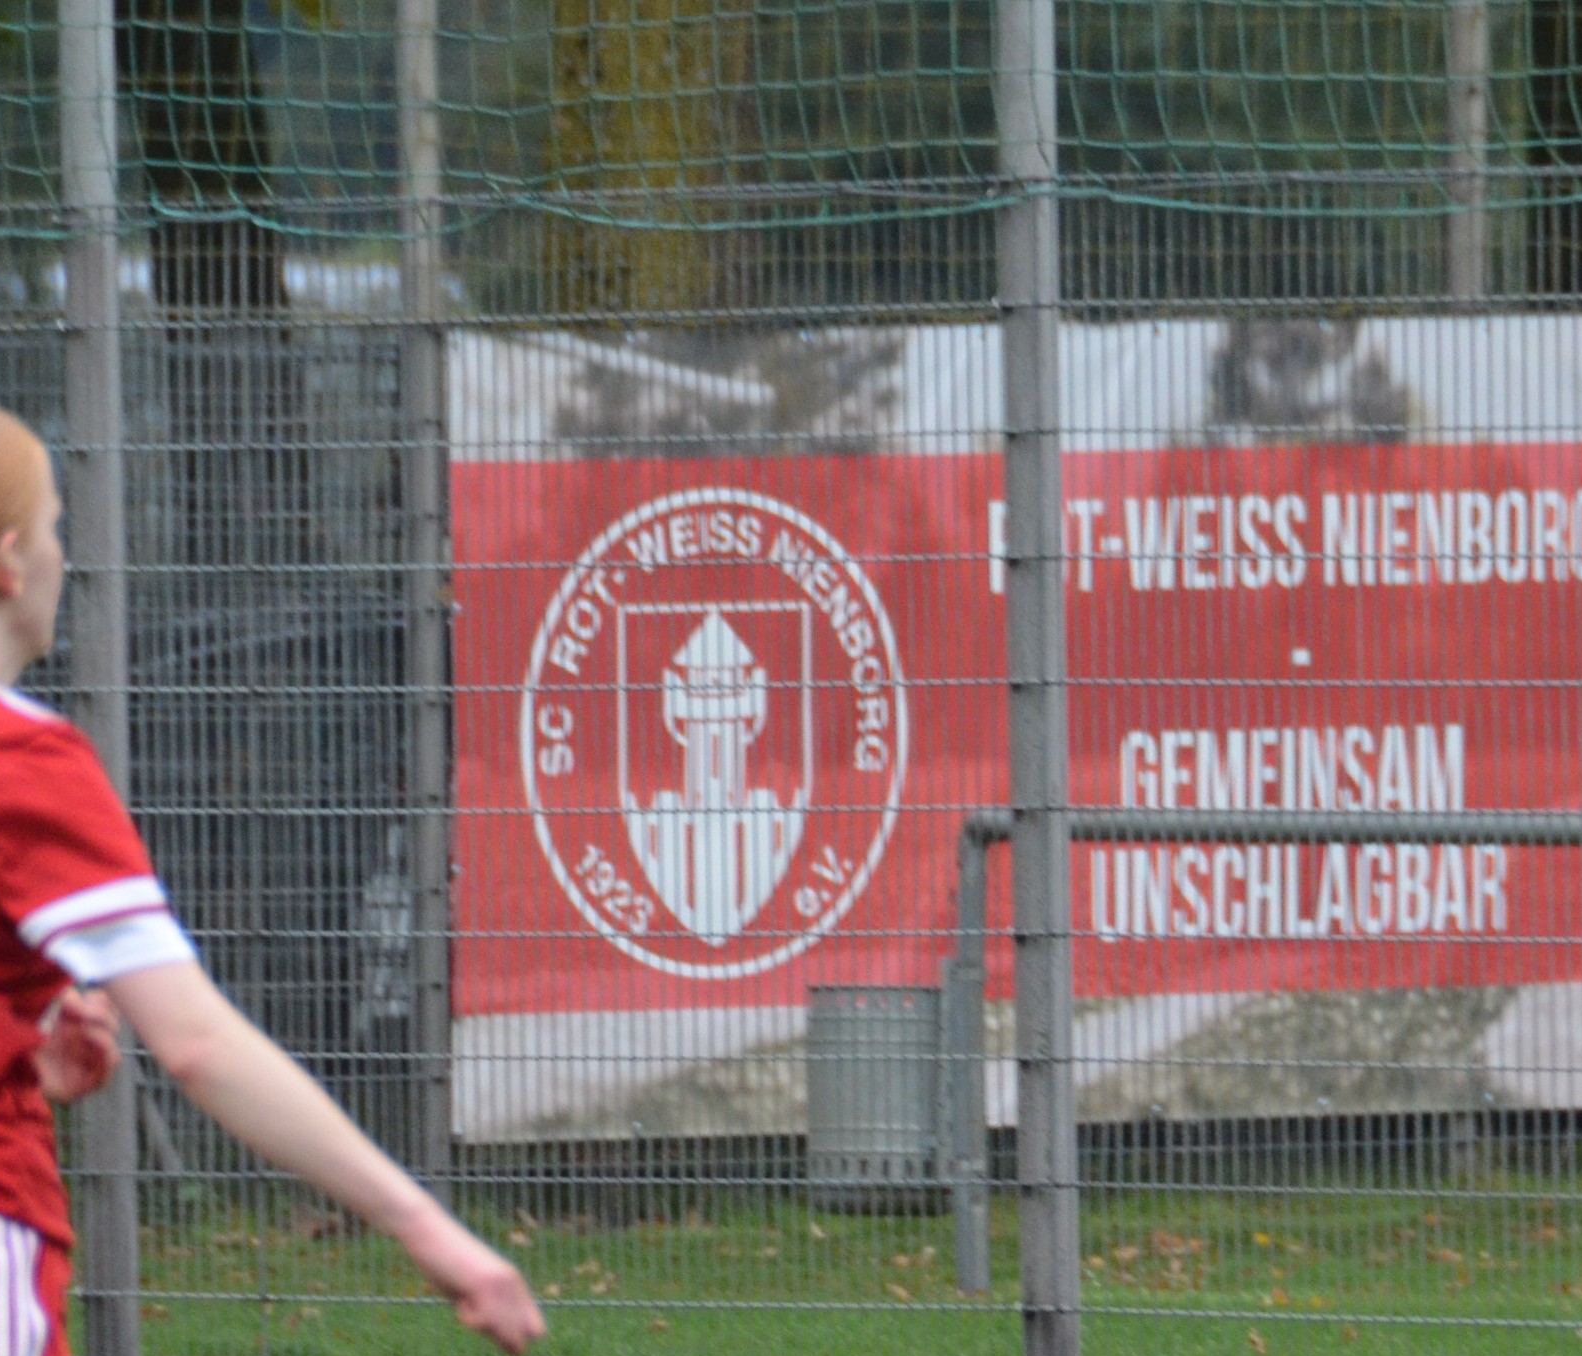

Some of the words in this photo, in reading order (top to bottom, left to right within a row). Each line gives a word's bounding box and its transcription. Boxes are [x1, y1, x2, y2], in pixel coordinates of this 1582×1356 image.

[537, 703, 575, 778] SC
[769, 527, 890, 773] NIENBORG
[1122, 723, 1465, 811] GEMEINSAM
[574, 842, 657, 934] 1923
[1089, 842, 1509, 942] UNSCHLAGBAR
